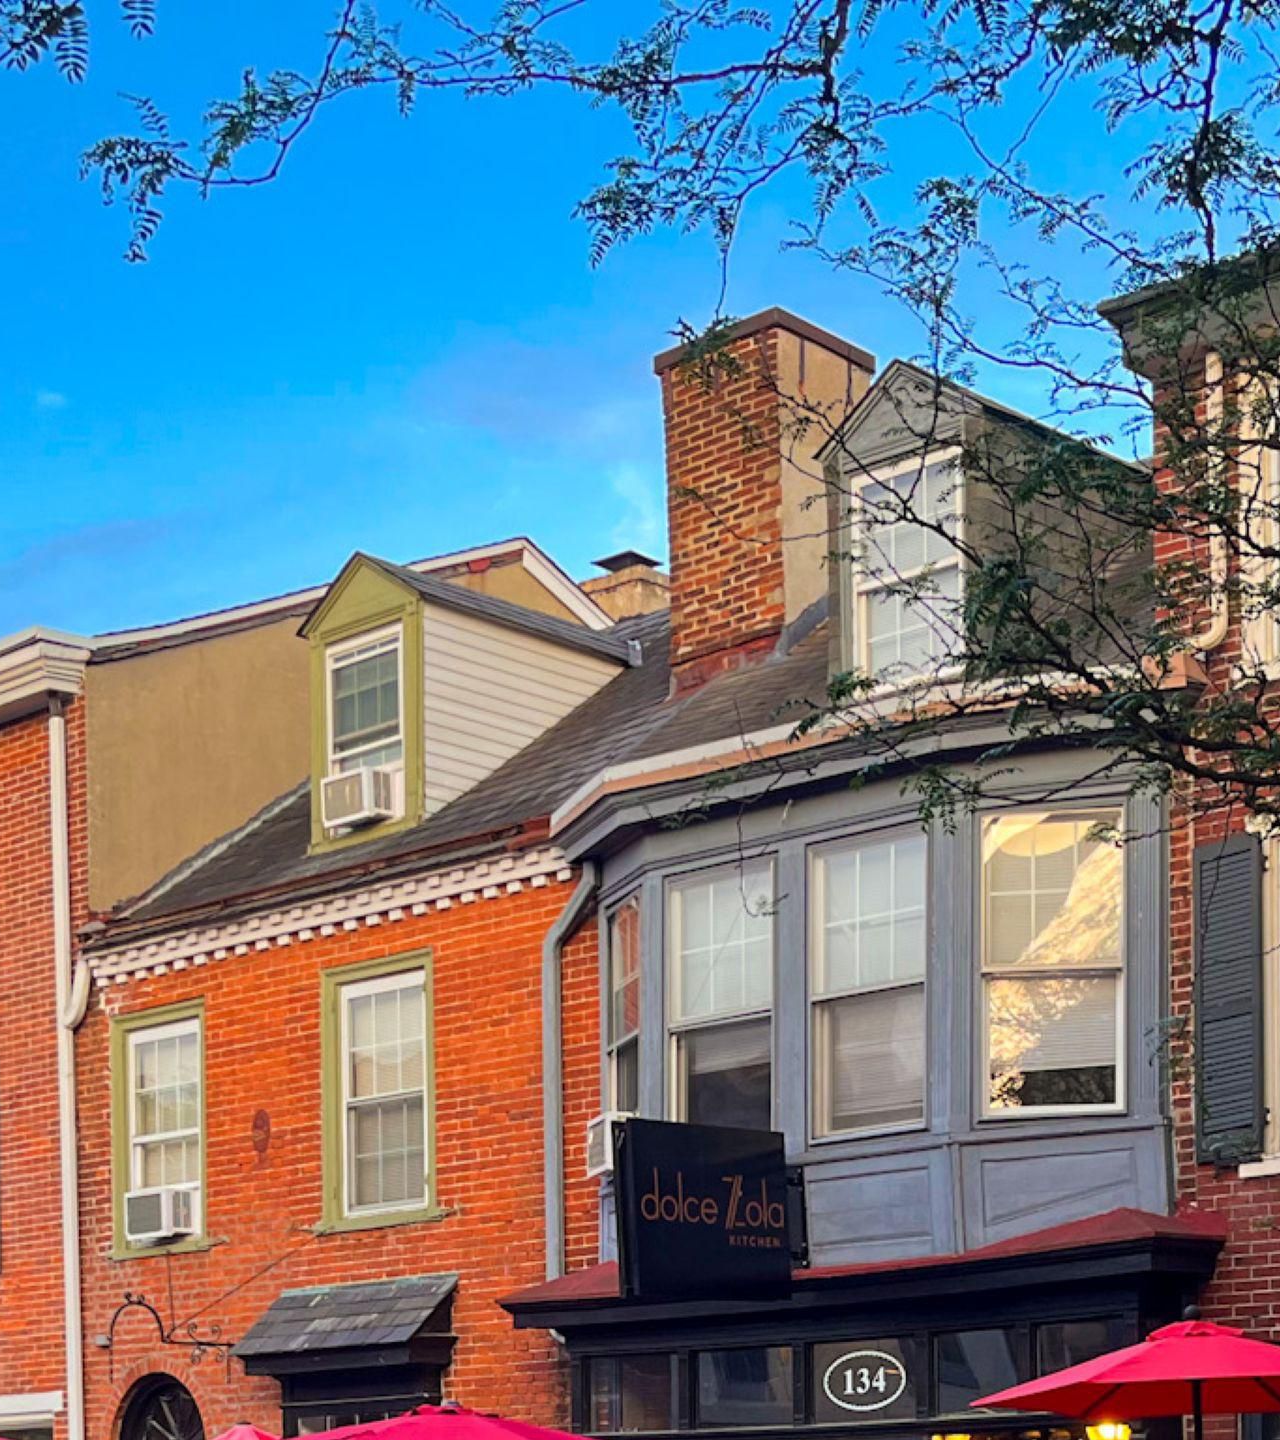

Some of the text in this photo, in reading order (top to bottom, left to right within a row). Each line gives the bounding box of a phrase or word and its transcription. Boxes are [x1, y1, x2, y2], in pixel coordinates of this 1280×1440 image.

[640, 1167, 785, 1230] dolce Zola
[729, 1236, 781, 1248] KITCHEN
[843, 1366, 886, 1395] 134
